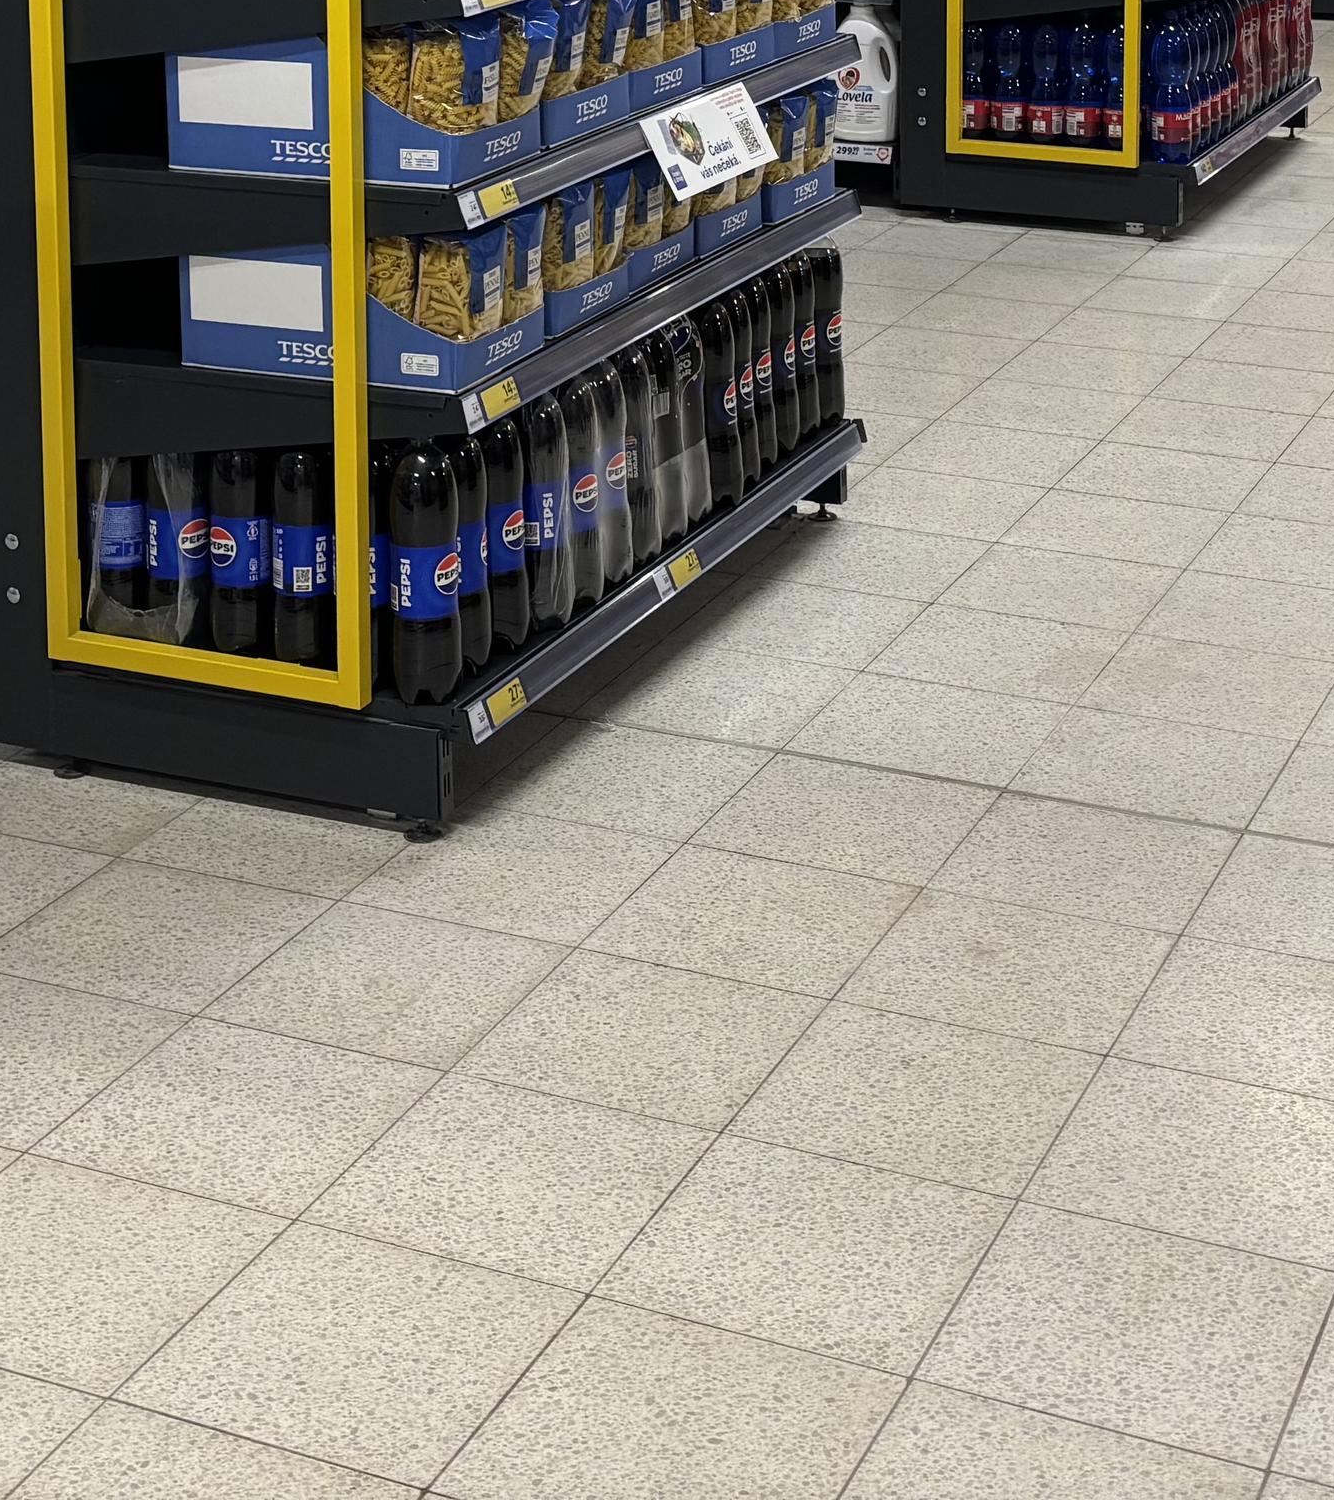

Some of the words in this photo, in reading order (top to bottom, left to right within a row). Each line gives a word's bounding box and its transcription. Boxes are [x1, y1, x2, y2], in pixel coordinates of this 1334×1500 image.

[701, 165, 713, 179] vás
[714, 154, 741, 175] nečeká.
[707, 137, 734, 156] Čekání
[544, 492, 555, 539] PEPSI
[148, 519, 158, 567] PEPSI
[316, 535, 327, 584] PEPSI
[400, 558, 411, 607] PEPSI
